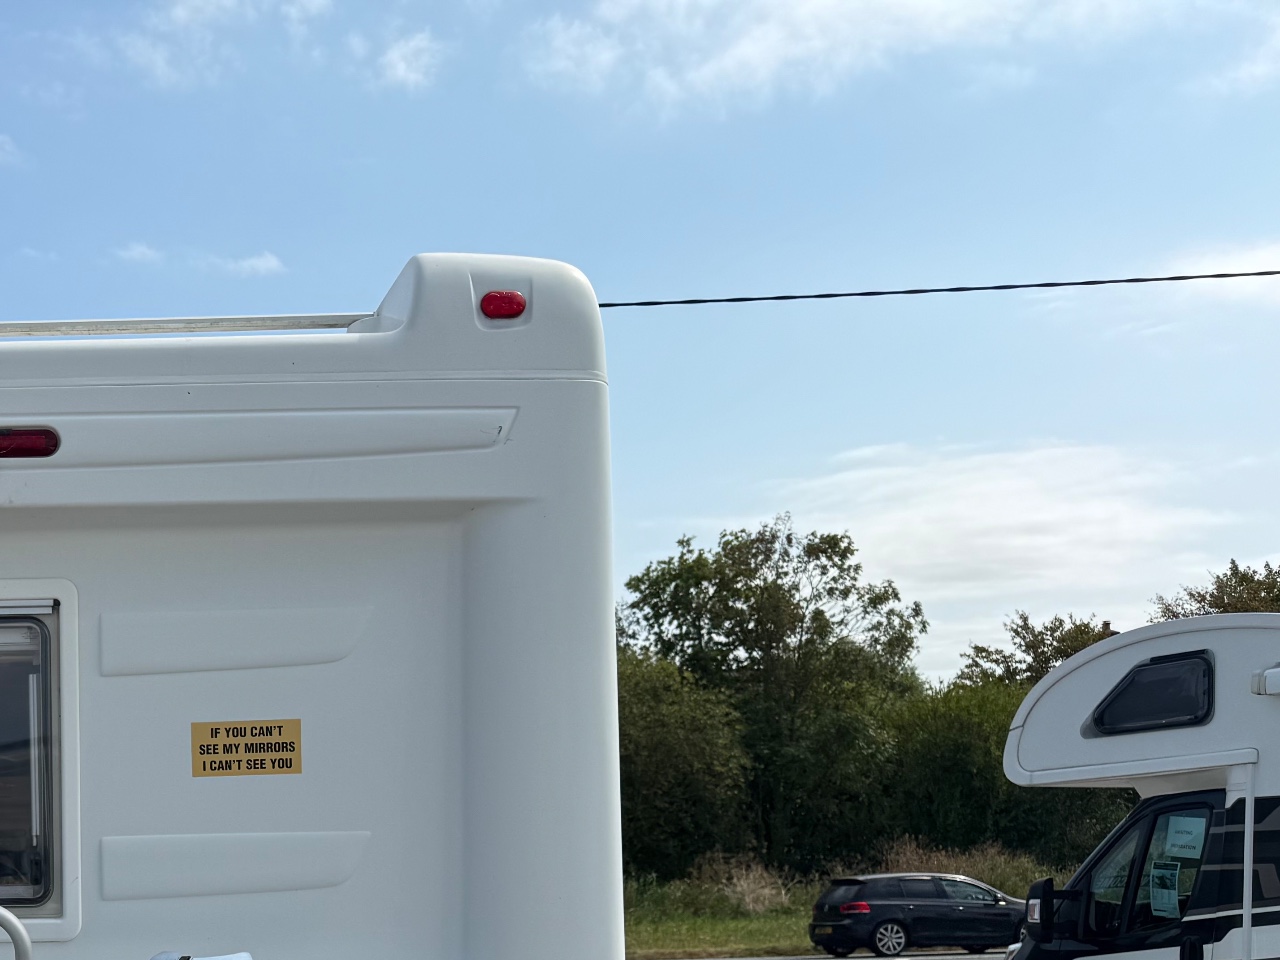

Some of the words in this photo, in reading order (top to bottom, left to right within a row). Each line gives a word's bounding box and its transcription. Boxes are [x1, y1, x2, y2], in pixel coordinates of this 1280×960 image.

[210, 727, 220, 739] IF
[224, 726, 247, 739] YOU
[250, 725, 284, 738] CAN'T
[199, 743, 219, 756] SEE
[222, 743, 241, 755] MY
[244, 741, 296, 754] MIRRORS
[202, 760, 207, 772] I
[209, 759, 243, 772] CAN'T
[246, 758, 267, 770] SEE
[270, 757, 293, 770] YOU
